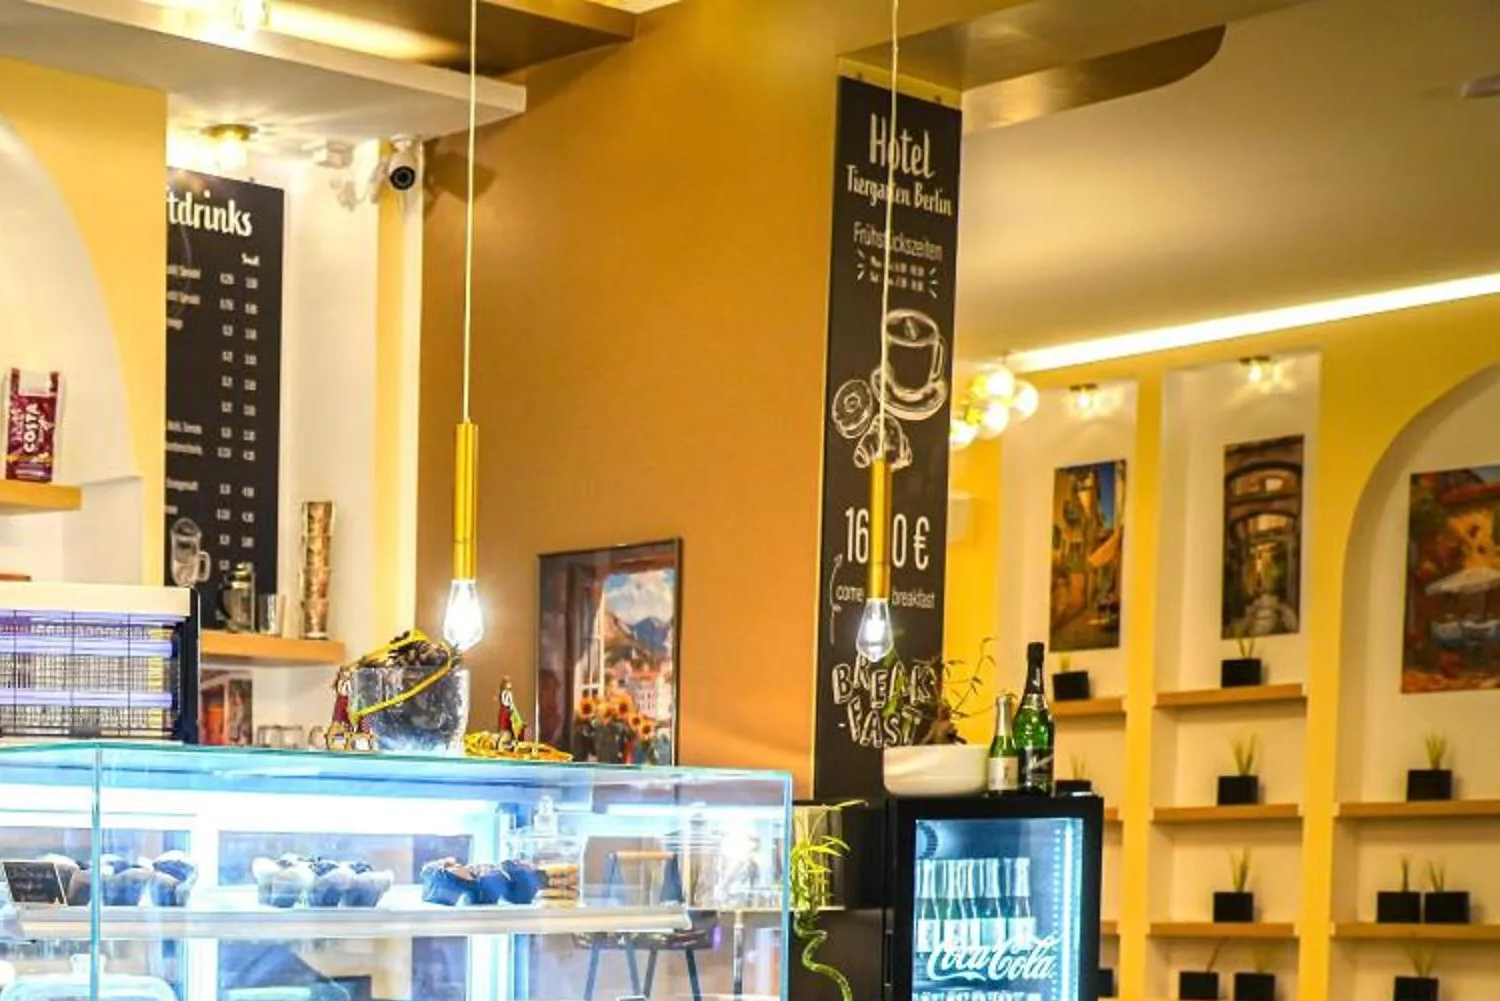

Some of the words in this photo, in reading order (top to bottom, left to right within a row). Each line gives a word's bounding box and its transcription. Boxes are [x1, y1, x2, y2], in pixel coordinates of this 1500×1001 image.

[868, 112, 937, 179] Hotel
[166, 190, 253, 237] tdrinks
[846, 164, 911, 207] Tiergaen
[913, 181, 953, 217] Berlin
[853, 220, 943, 262] Frühsckszeiten
[23, 403, 40, 453] COSTA
[845, 507, 907, 568] 160
[891, 587, 935, 609] breakfast
